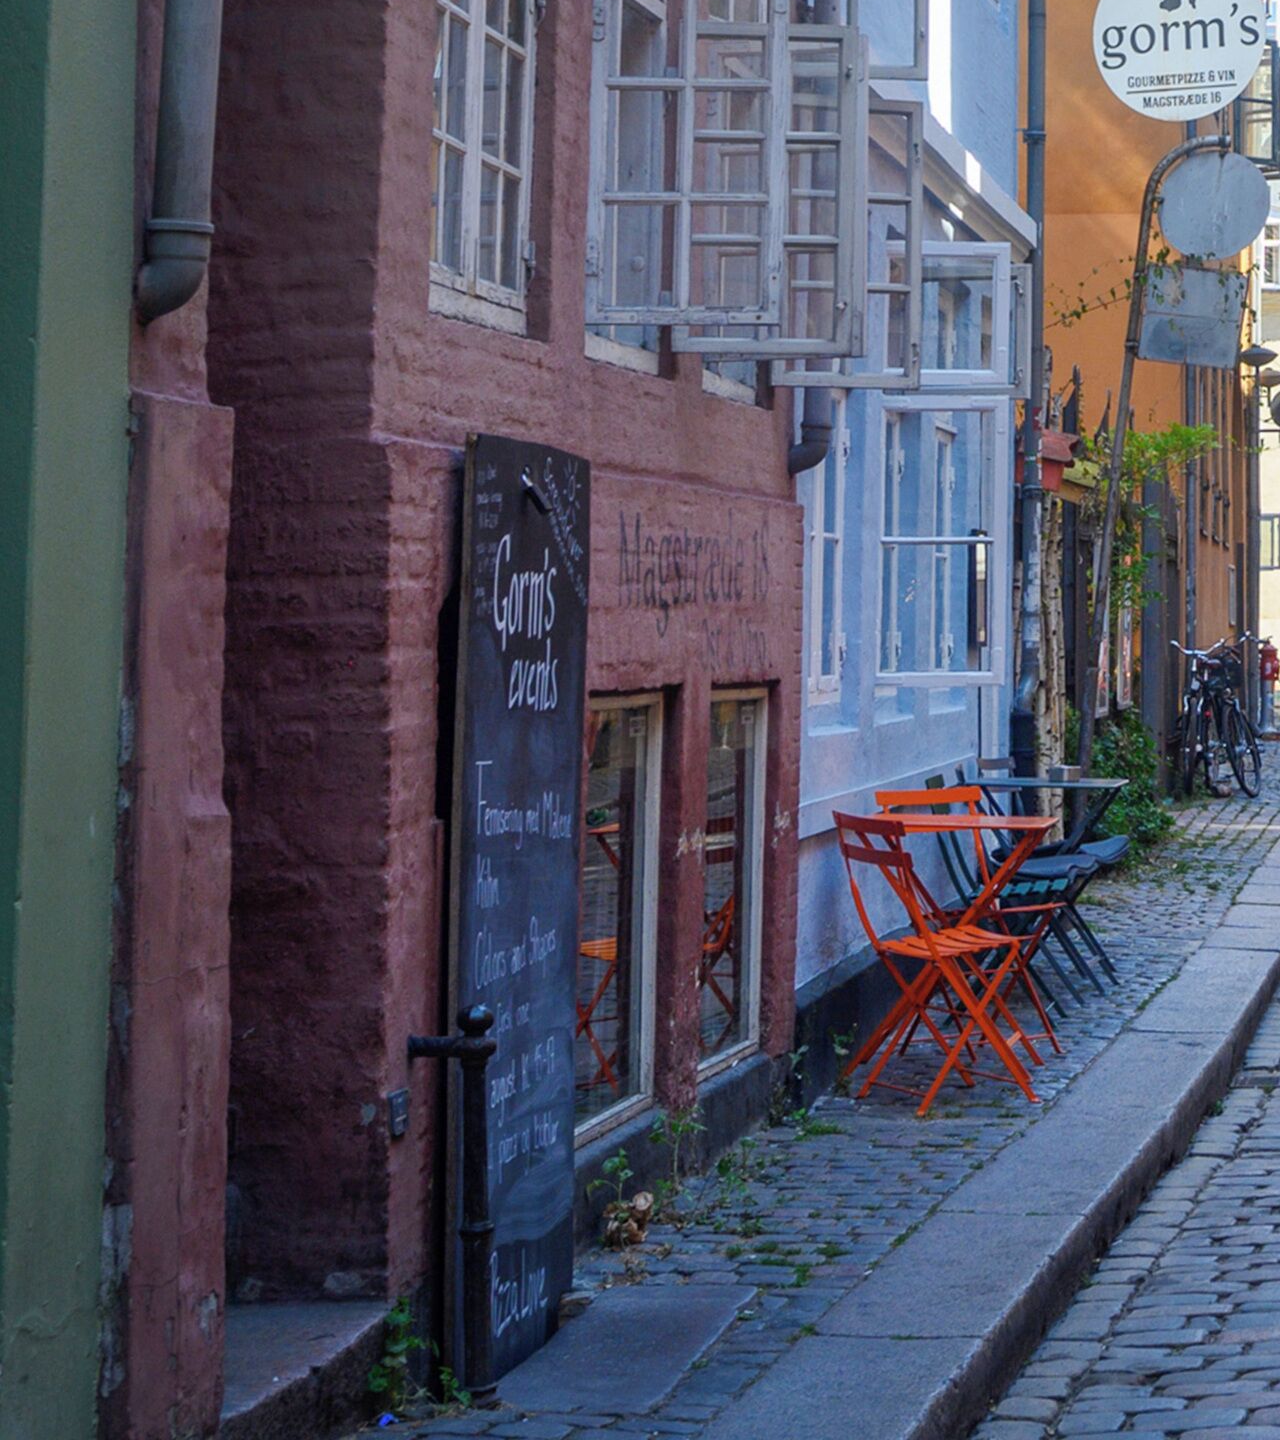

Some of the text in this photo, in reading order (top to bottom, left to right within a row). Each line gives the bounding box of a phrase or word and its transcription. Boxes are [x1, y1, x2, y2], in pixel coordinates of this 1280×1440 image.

[1101, 2, 1260, 70] gorm's
[1127, 69, 1236, 88] GOURMETPIZZE & VIN
[1142, 91, 1222, 109] MAGSTRÆDE 16
[493, 533, 557, 652] Gorm's
[617, 507, 745, 638] Magstræde
[508, 638, 559, 711] events
[525, 801, 540, 835] med
[474, 929, 507, 991] Colors
[510, 934, 527, 975] and
